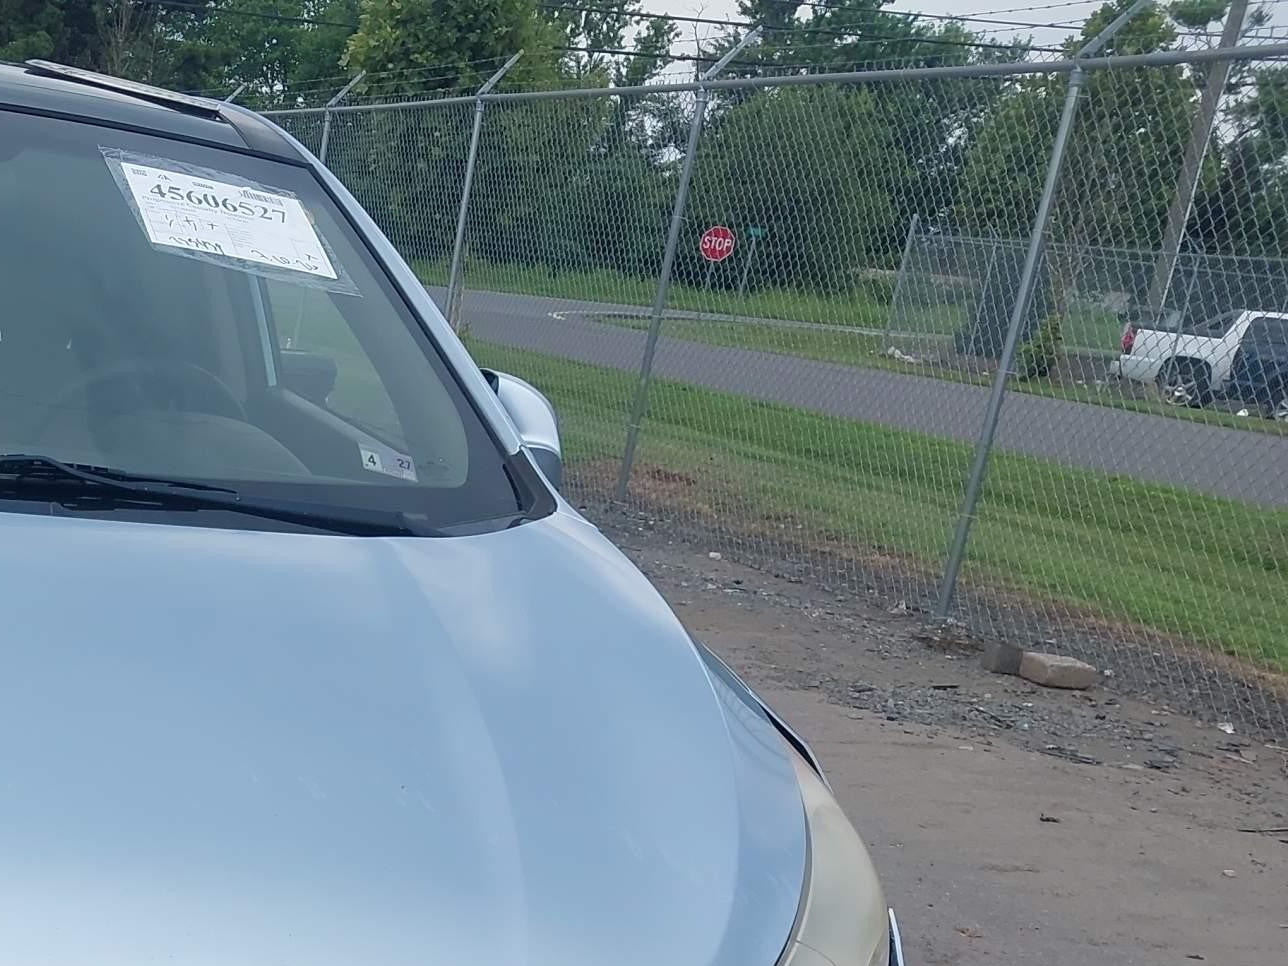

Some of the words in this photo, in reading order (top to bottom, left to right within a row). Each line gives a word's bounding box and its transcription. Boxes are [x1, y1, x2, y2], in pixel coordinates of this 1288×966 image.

[150, 183, 286, 224] 45606527
[702, 235, 732, 251] STOP
[368, 454, 376, 466] 4
